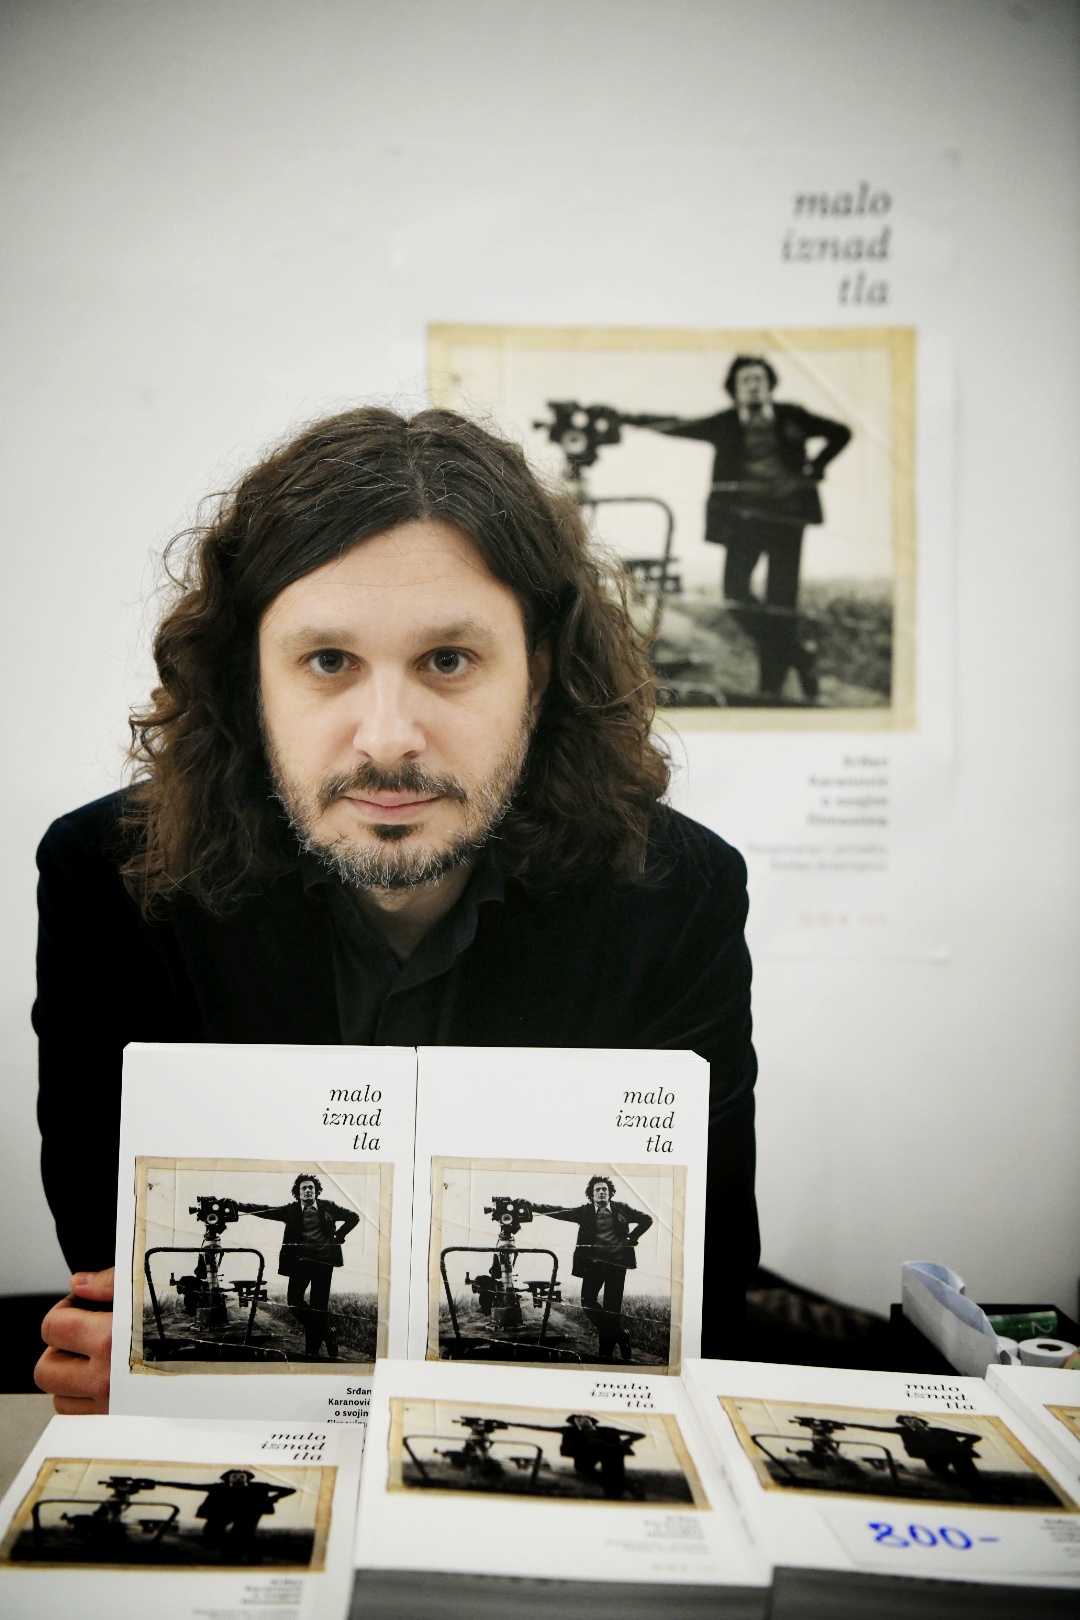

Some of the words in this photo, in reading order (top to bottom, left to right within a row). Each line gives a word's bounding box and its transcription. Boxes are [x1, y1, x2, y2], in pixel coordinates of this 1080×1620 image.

[792, 180, 892, 218] malo
[781, 224, 892, 263] iznad
[838, 270, 889, 306] tla
[329, 1084, 382, 1103] malo
[622, 1086, 675, 1106] malo
[322, 1107, 382, 1127] iznad
[615, 1109, 675, 1129] iznad
[353, 1132, 381, 1151] tla
[646, 1134, 674, 1153] tla
[346, 1387, 372, 1396] Srđan
[594, 1382, 650, 1391] malo
[904, 1383, 961, 1392] malo
[590, 1389, 652, 1400] iznad
[905, 1391, 969, 1402] iznad
[626, 1400, 656, 1409] tla
[945, 1401, 977, 1411] tla
[270, 1432, 327, 1441] malo
[261, 1441, 326, 1451] iznad
